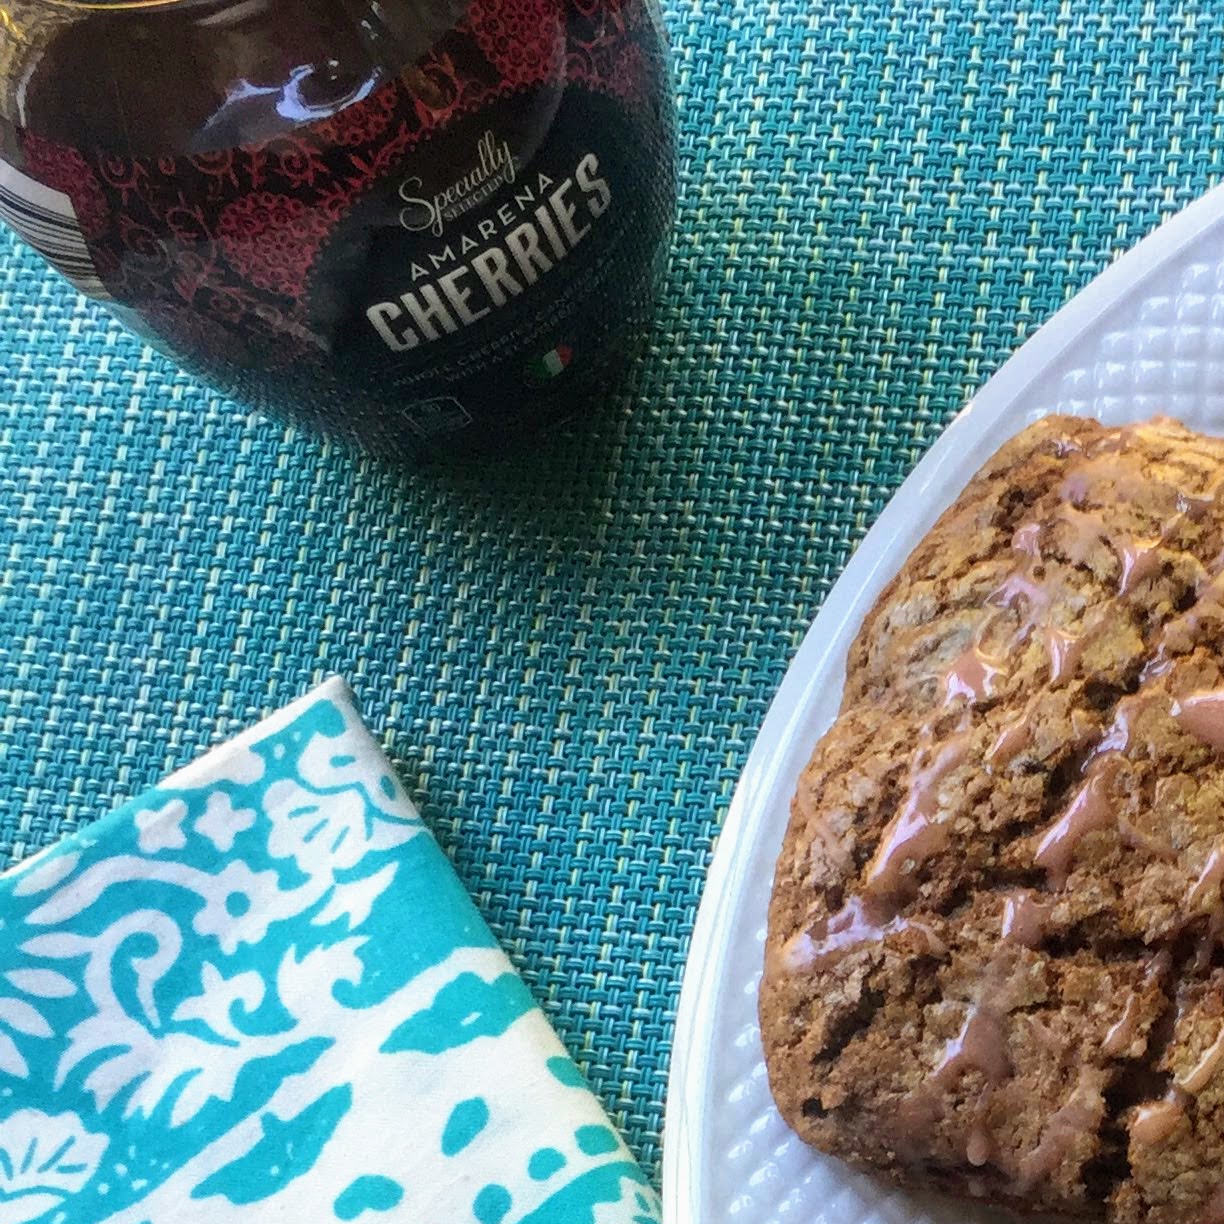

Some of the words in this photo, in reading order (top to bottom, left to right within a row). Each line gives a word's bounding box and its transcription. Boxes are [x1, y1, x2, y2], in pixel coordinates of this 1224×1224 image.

[399, 130, 516, 238] Specially
[410, 172, 554, 282] AMARENA
[443, 174, 506, 222] SELECTED
[366, 152, 612, 351] CHERRIES
